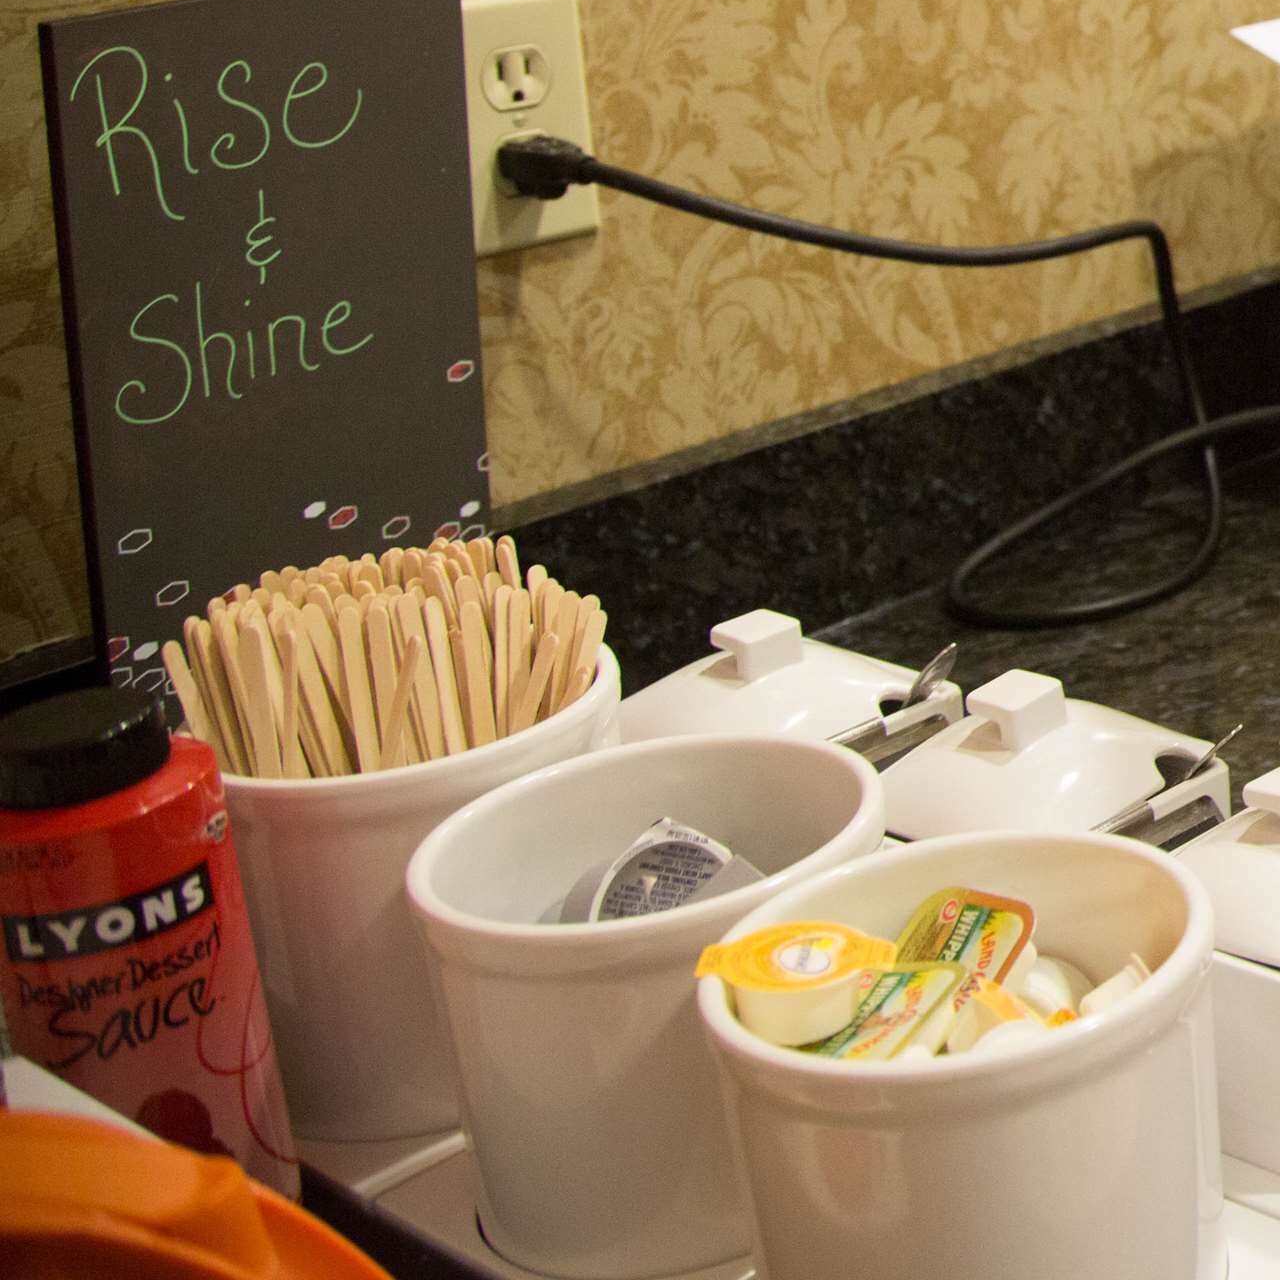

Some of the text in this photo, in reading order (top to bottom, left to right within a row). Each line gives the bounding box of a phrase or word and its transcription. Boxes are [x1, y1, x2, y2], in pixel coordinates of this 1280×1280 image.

[70, 46, 363, 220] Rise
[244, 188, 283, 285] &
[114, 281, 374, 424] Shine
[17, 873, 206, 957] LYONS
[127, 921, 222, 991] Dessert
[47, 977, 217, 1070] Sauce
